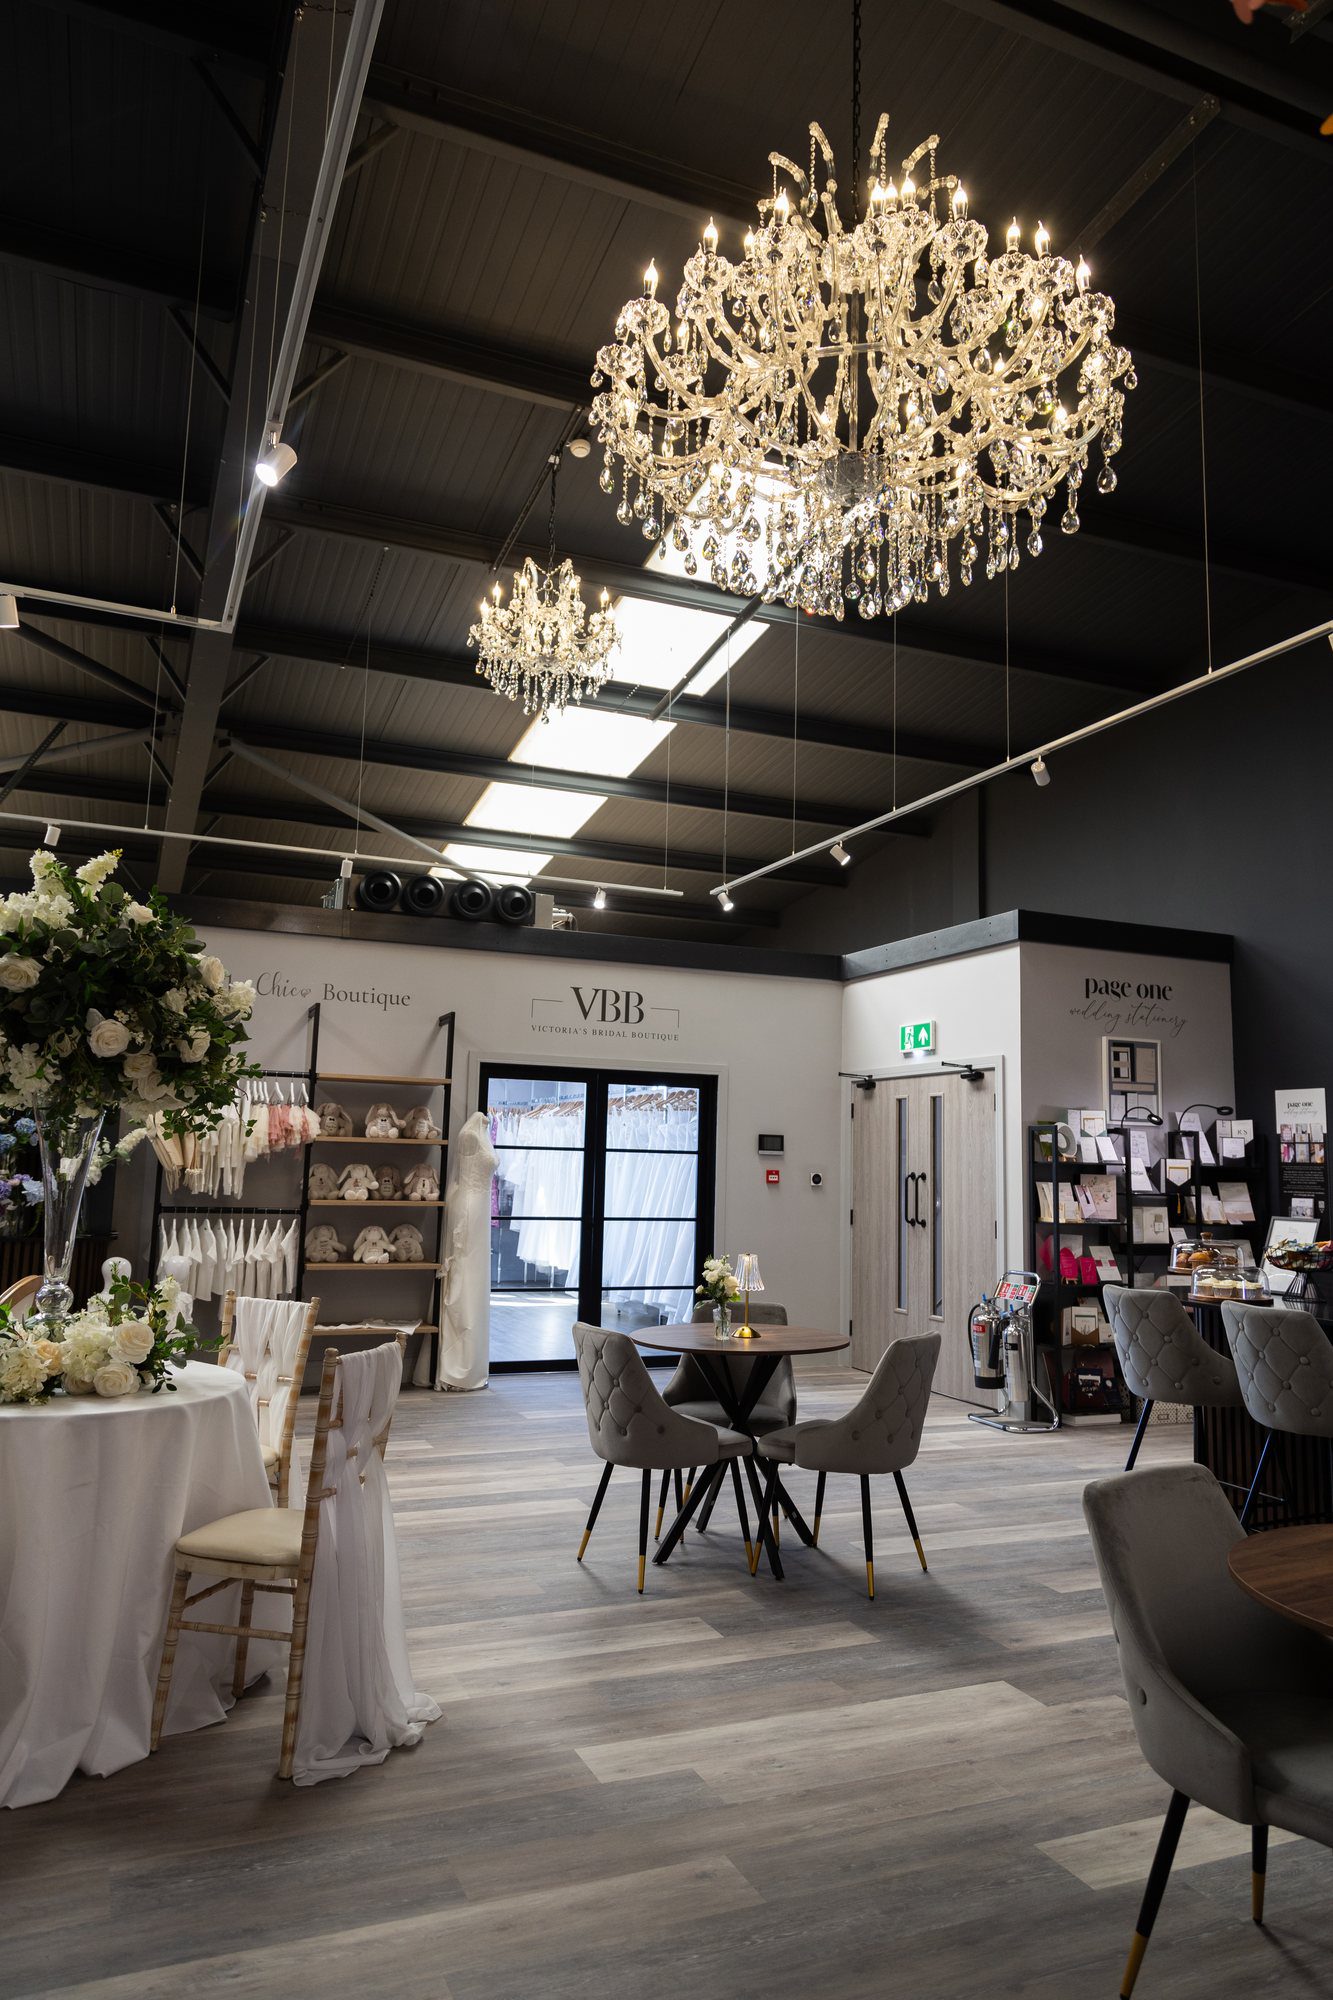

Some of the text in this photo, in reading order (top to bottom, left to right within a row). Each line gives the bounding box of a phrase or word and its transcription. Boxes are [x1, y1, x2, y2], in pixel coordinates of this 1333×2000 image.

[323, 983, 411, 1011] Boutique
[1085, 978, 1173, 1000] page one
[570, 986, 645, 1025] VBB
[1069, 1000, 1187, 1038] wedding stationery
[531, 1024, 680, 1042] VICTORIA'S BRIDAL BOUTIQUE
